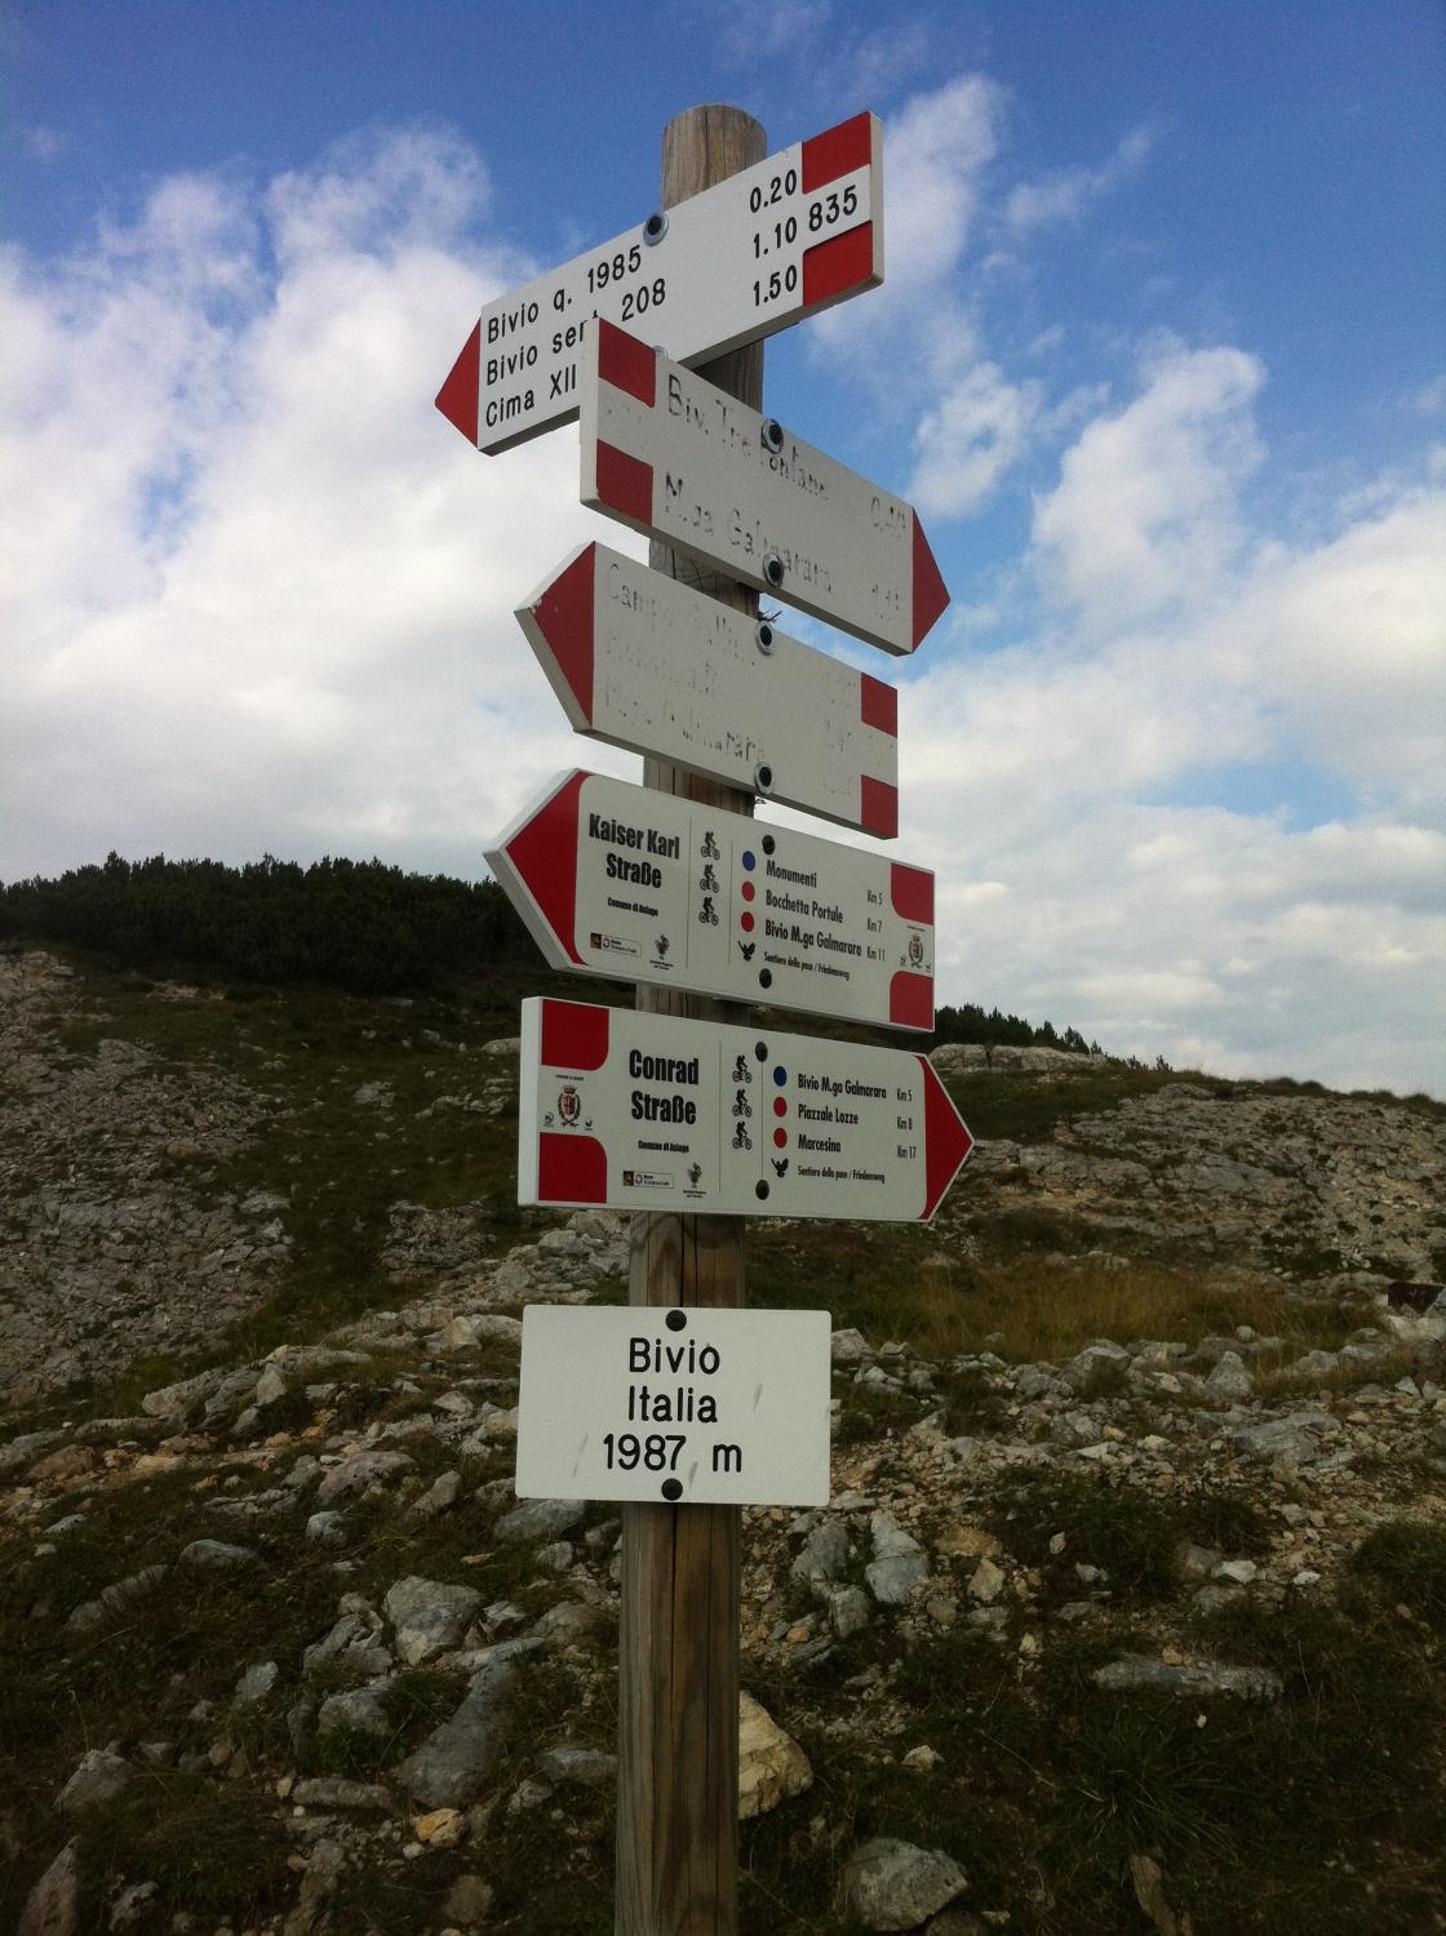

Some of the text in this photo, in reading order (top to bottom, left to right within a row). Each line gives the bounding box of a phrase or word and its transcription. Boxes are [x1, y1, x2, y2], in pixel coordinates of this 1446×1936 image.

[750, 169, 797, 213] 0.20
[809, 185, 857, 231] 835
[753, 217, 797, 258] 1.10
[488, 244, 641, 343] Bivio q. 1985
[753, 265, 797, 306] 1.50
[487, 345, 538, 386] Bivio
[621, 278, 666, 321] 208
[486, 364, 576, 427] Cima XII
[589, 812, 680, 859] Kaiser Karl
[606, 852, 662, 888] Straße
[766, 859, 817, 888] Monumenti
[766, 889, 843, 923] Bocchetta Portule
[866, 889, 883, 906] Km 5
[765, 919, 862, 957] Bivio M.ga Galmarara
[866, 918, 883, 933] Km 7
[866, 946, 885, 962] Km 11
[629, 1049, 699, 1085] Conrad
[798, 1073, 887, 1099] Bivio M.ga Galmarara
[896, 1088, 912, 1102] Km 5
[631, 1091, 697, 1125] Straße
[798, 1103, 858, 1124] Piazzale Lozze
[896, 1116, 906, 1130] Km
[798, 1134, 841, 1152] Marcesina
[896, 1144, 917, 1159] Km 17
[629, 1337, 720, 1375] Bivio
[628, 1385, 718, 1423] Italia
[603, 1433, 742, 1473] 1987 m
